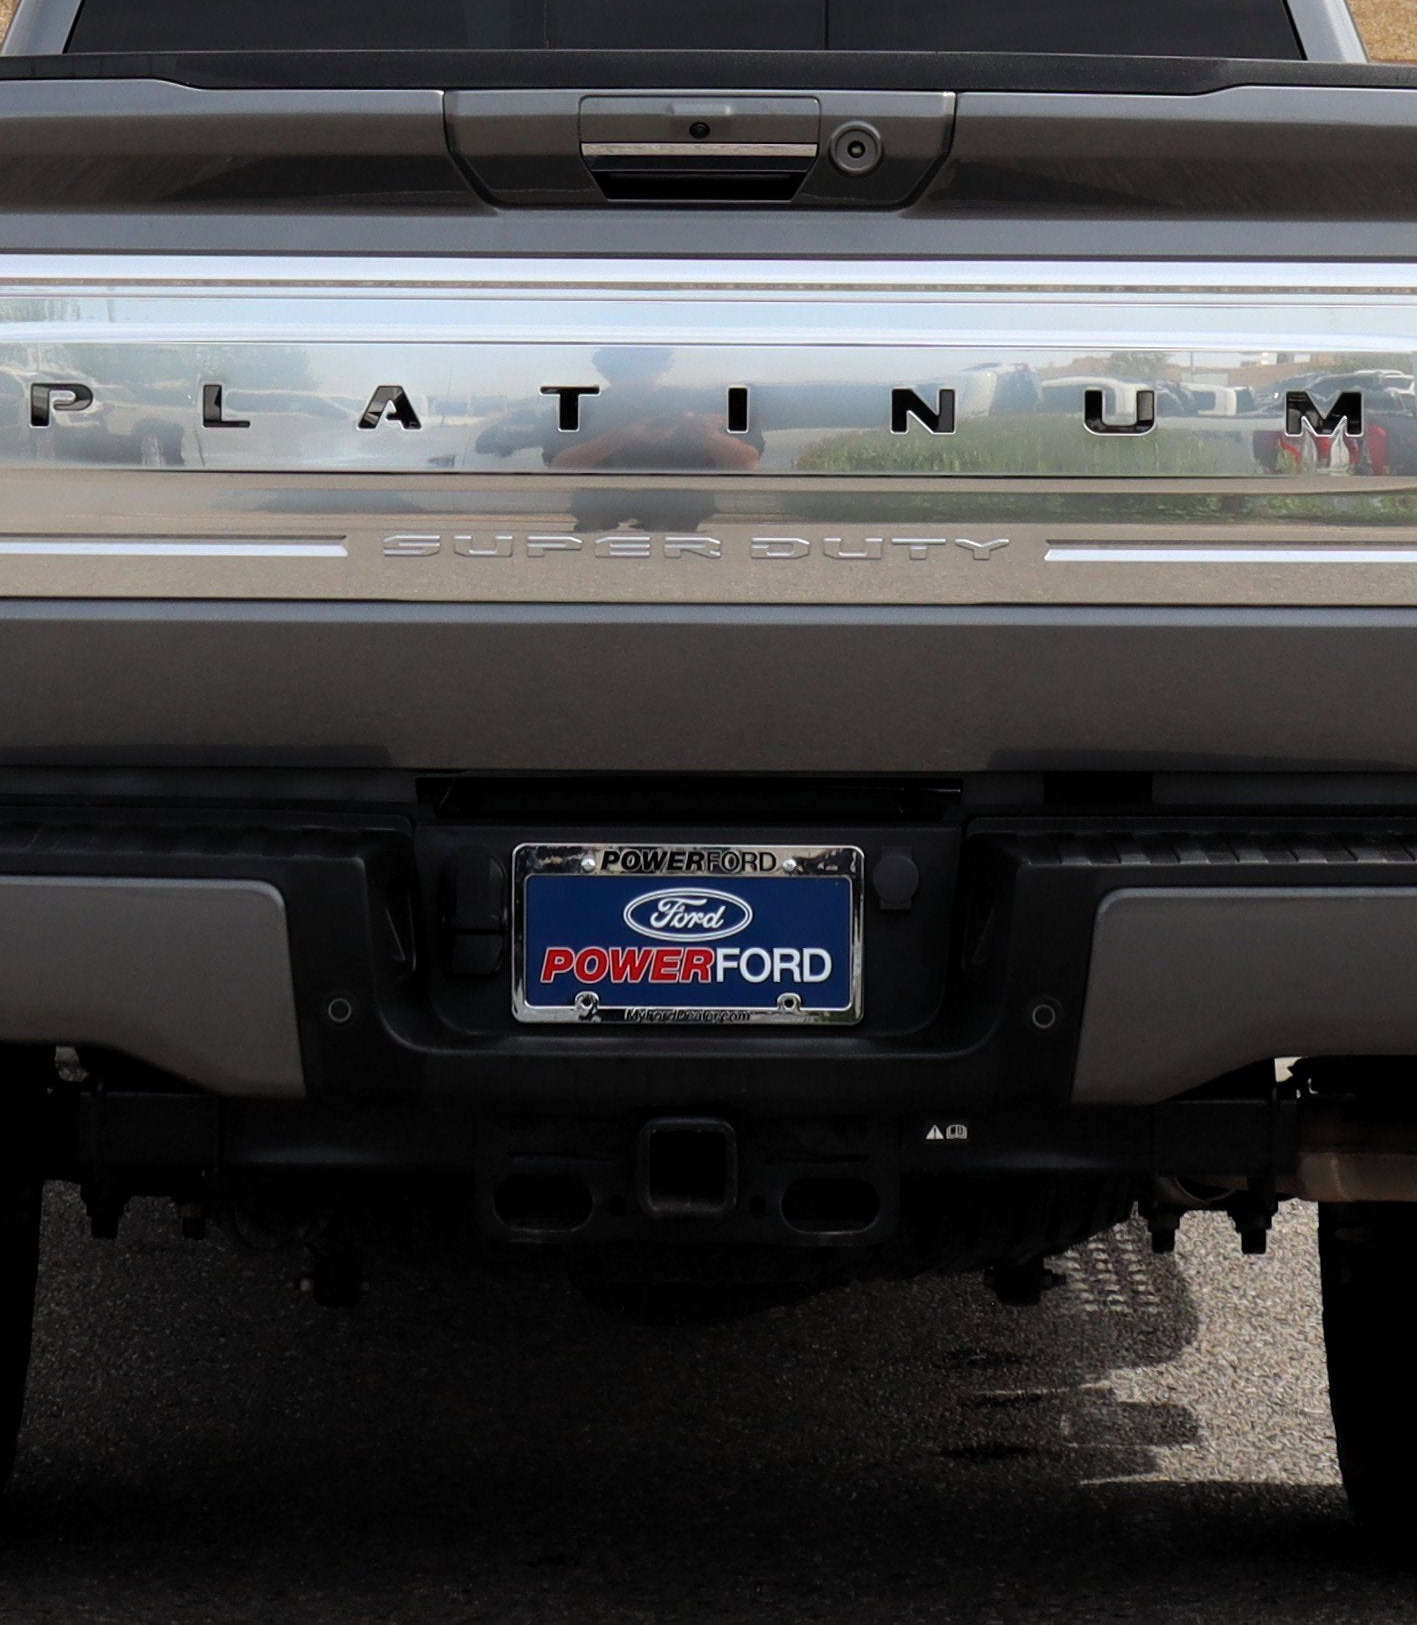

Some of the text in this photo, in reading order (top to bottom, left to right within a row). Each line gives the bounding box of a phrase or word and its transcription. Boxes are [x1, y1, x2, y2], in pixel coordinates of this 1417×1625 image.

[29, 383, 1364, 436] PLATINUM
[383, 533, 1009, 561] SUPER DUTY
[600, 850, 777, 873] POWERFORD
[649, 897, 727, 930] Ford
[540, 946, 832, 984] POWERFORD
